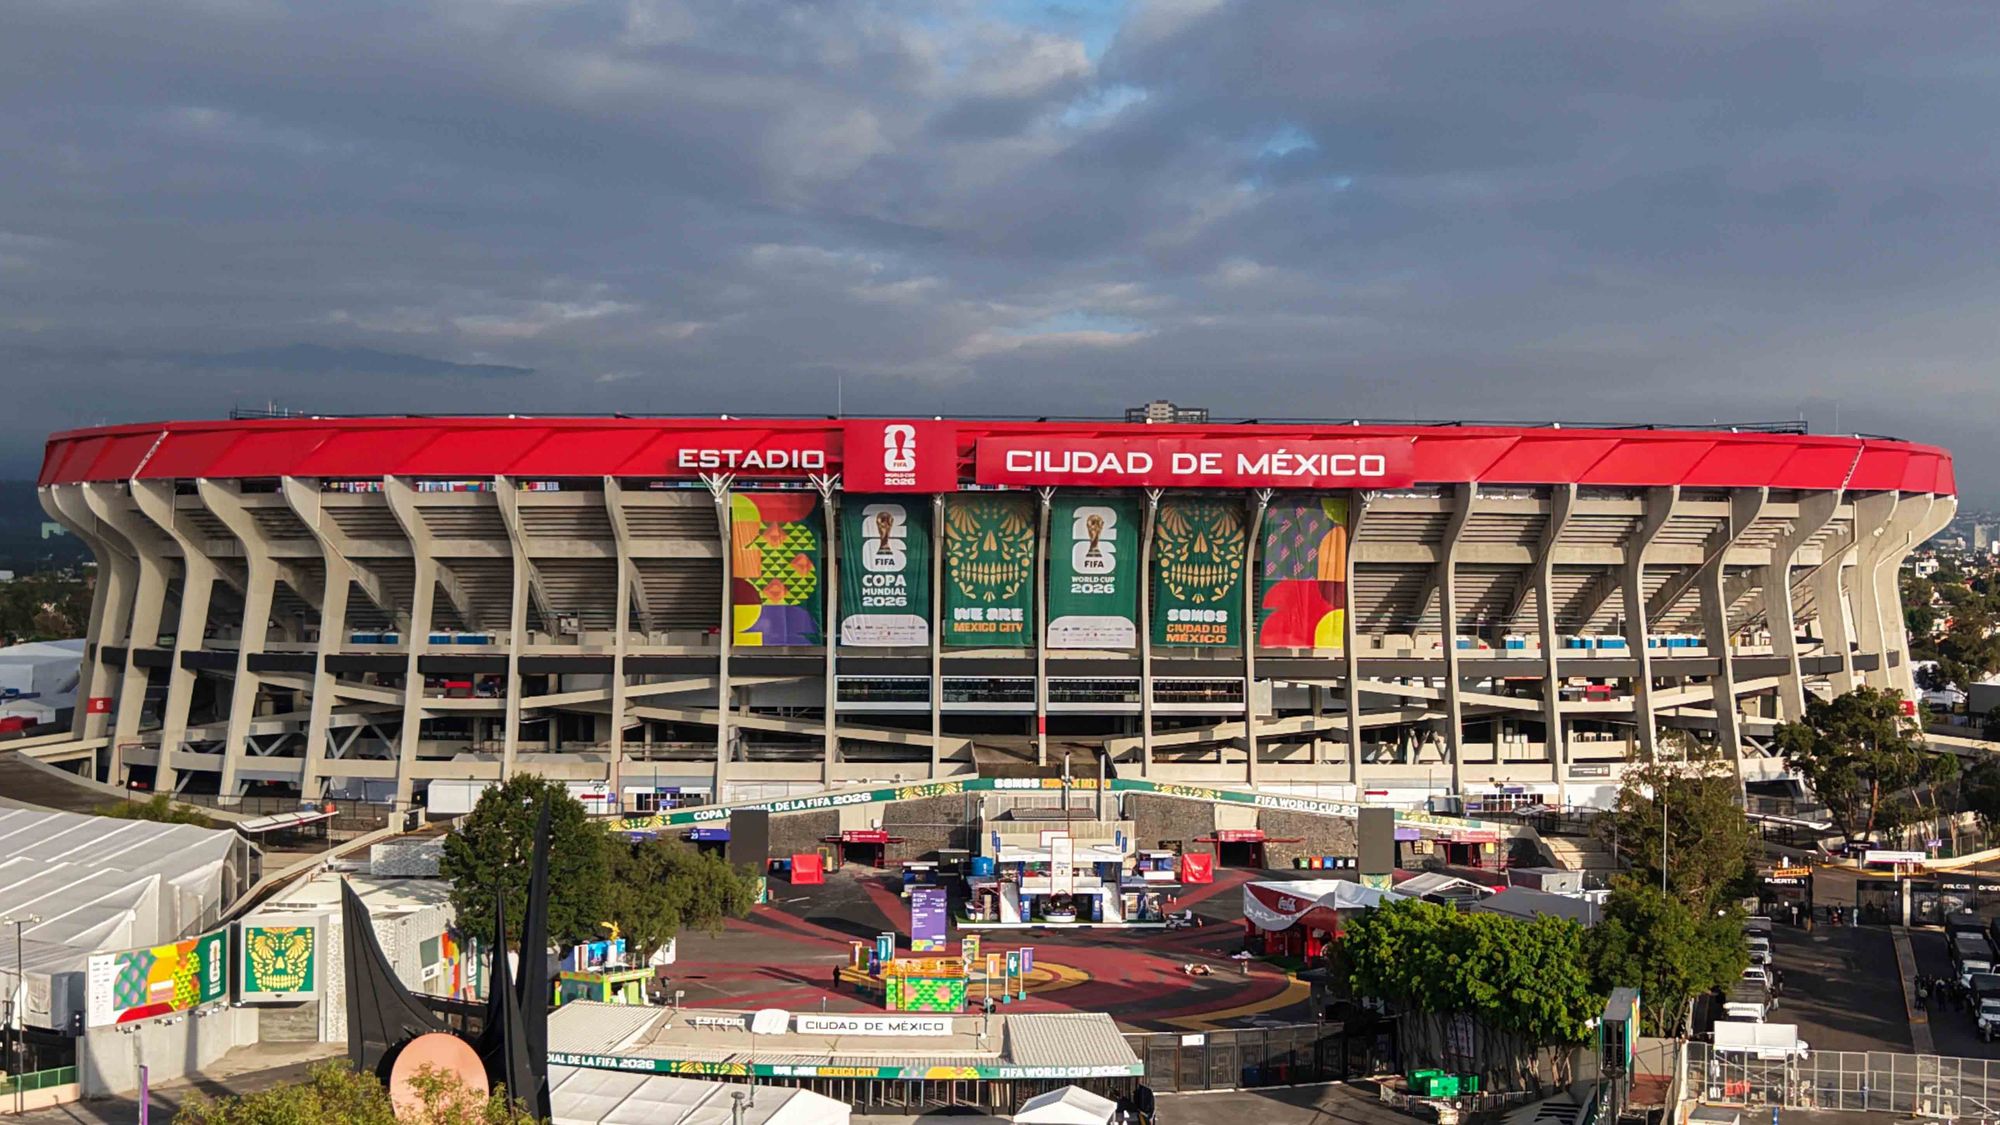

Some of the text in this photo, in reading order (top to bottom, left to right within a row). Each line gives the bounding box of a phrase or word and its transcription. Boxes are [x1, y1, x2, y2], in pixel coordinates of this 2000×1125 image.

[678, 448, 824, 469] ESTADIO
[1006, 449, 1386, 477] CIUDAD DE MÉXICO
[884, 478, 916, 486] 2026
[862, 574, 907, 587] COPA
[862, 588, 907, 596] MUNDIAL
[1071, 584, 1115, 594] 2026
[862, 596, 907, 607] 2026
[954, 608, 1023, 621] WE ARE
[1167, 608, 1228, 622] SOMOS
[954, 622, 1023, 632] MEXICO CITY
[1166, 624, 1227, 634] CIUDAD DE
[1166, 632, 1227, 644] MÉXICO
[96, 700, 104, 710] 6
[694, 810, 723, 820] COPA
[776, 802, 790, 812] DE
[791, 800, 806, 810] LA
[807, 798, 832, 808] FIFA
[832, 792, 872, 804] 2026
[1254, 796, 1280, 805] FIFA
[1280, 798, 1318, 810] WORLD
[1319, 804, 1340, 812] CUP
[696, 1016, 745, 1026] ESTADIO
[806, 1020, 944, 1031] CIUDAD DE MÉXICO
[567, 1054, 580, 1064] DE
[582, 1056, 594, 1066] LA
[596, 1058, 618, 1068] FIFA
[619, 1059, 656, 1070] 2026
[1000, 1065, 1130, 1078] FIFA WORLD CUP 2026
